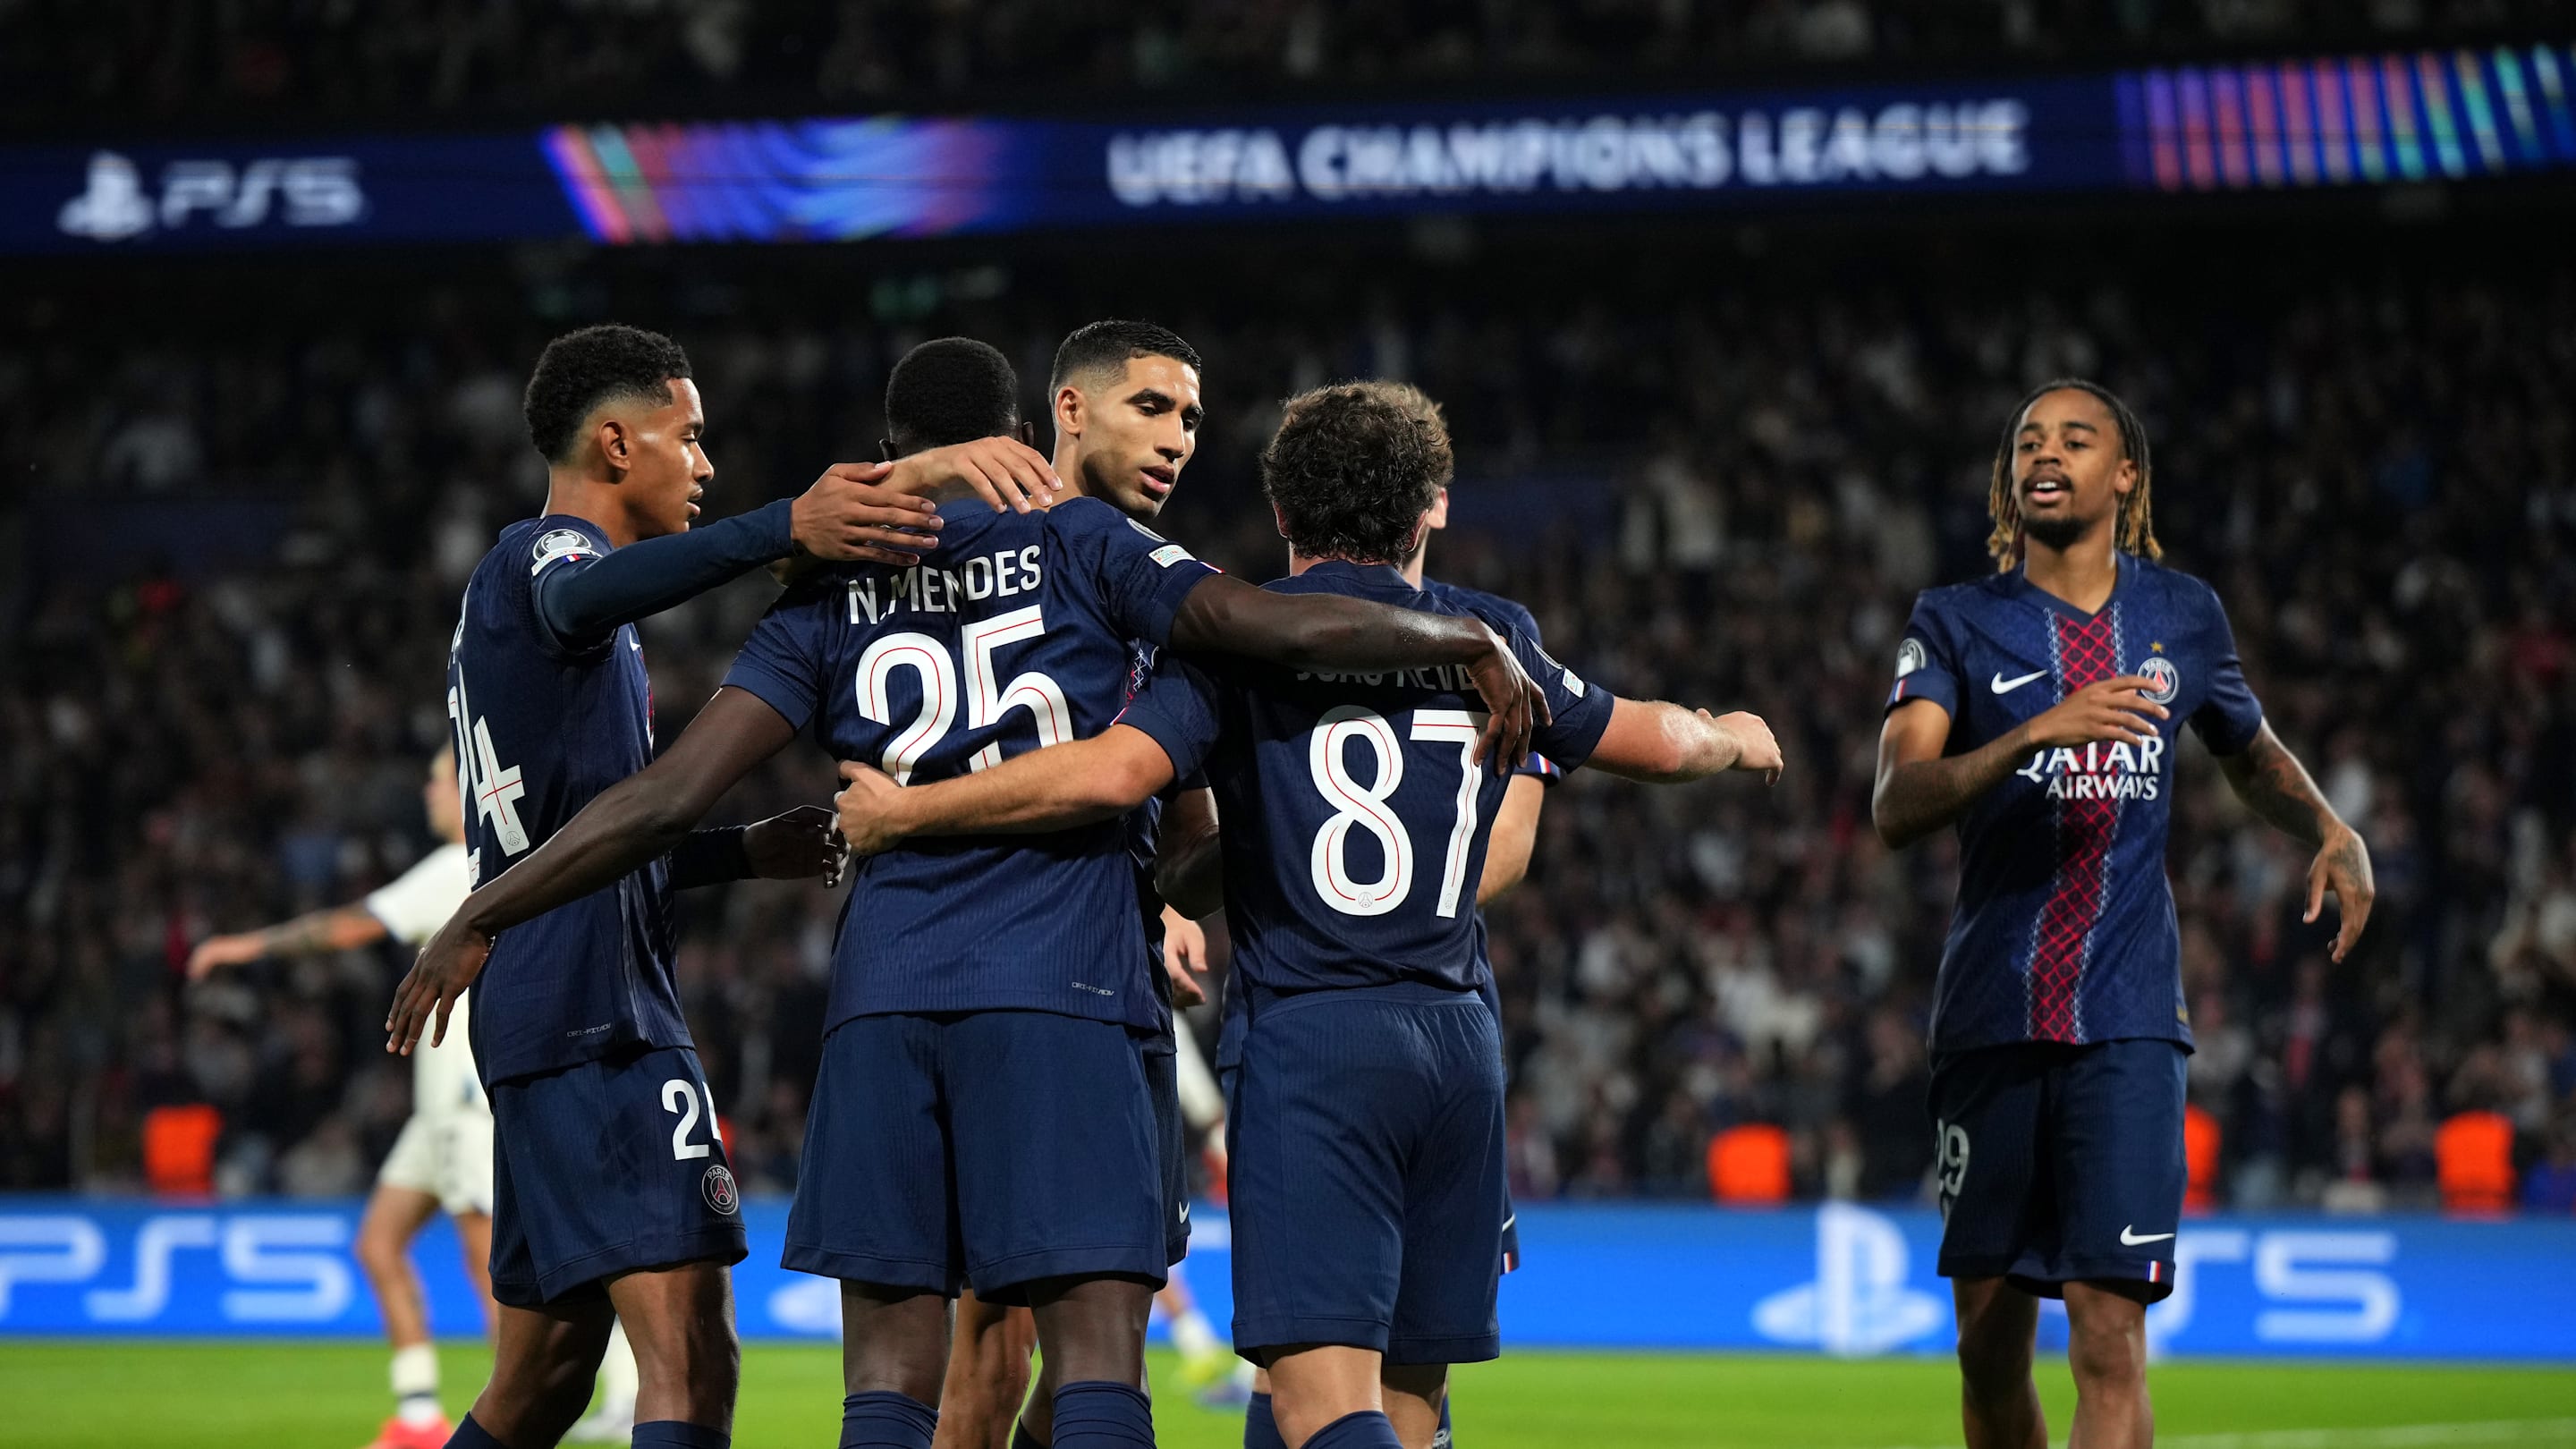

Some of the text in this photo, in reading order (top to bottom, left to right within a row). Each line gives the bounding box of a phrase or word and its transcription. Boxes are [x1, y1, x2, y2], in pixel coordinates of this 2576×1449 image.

[161, 157, 363, 227] PS5
[1107, 100, 2028, 204] UEFA CHAMPIONS LEAGUE
[855, 605, 1074, 787] 25
[1309, 705, 1488, 919] 87
[2046, 775, 2158, 801] AIRWAYS
[707, 1167, 730, 1182] PARIS
[0, 1215, 353, 1322] PS5
